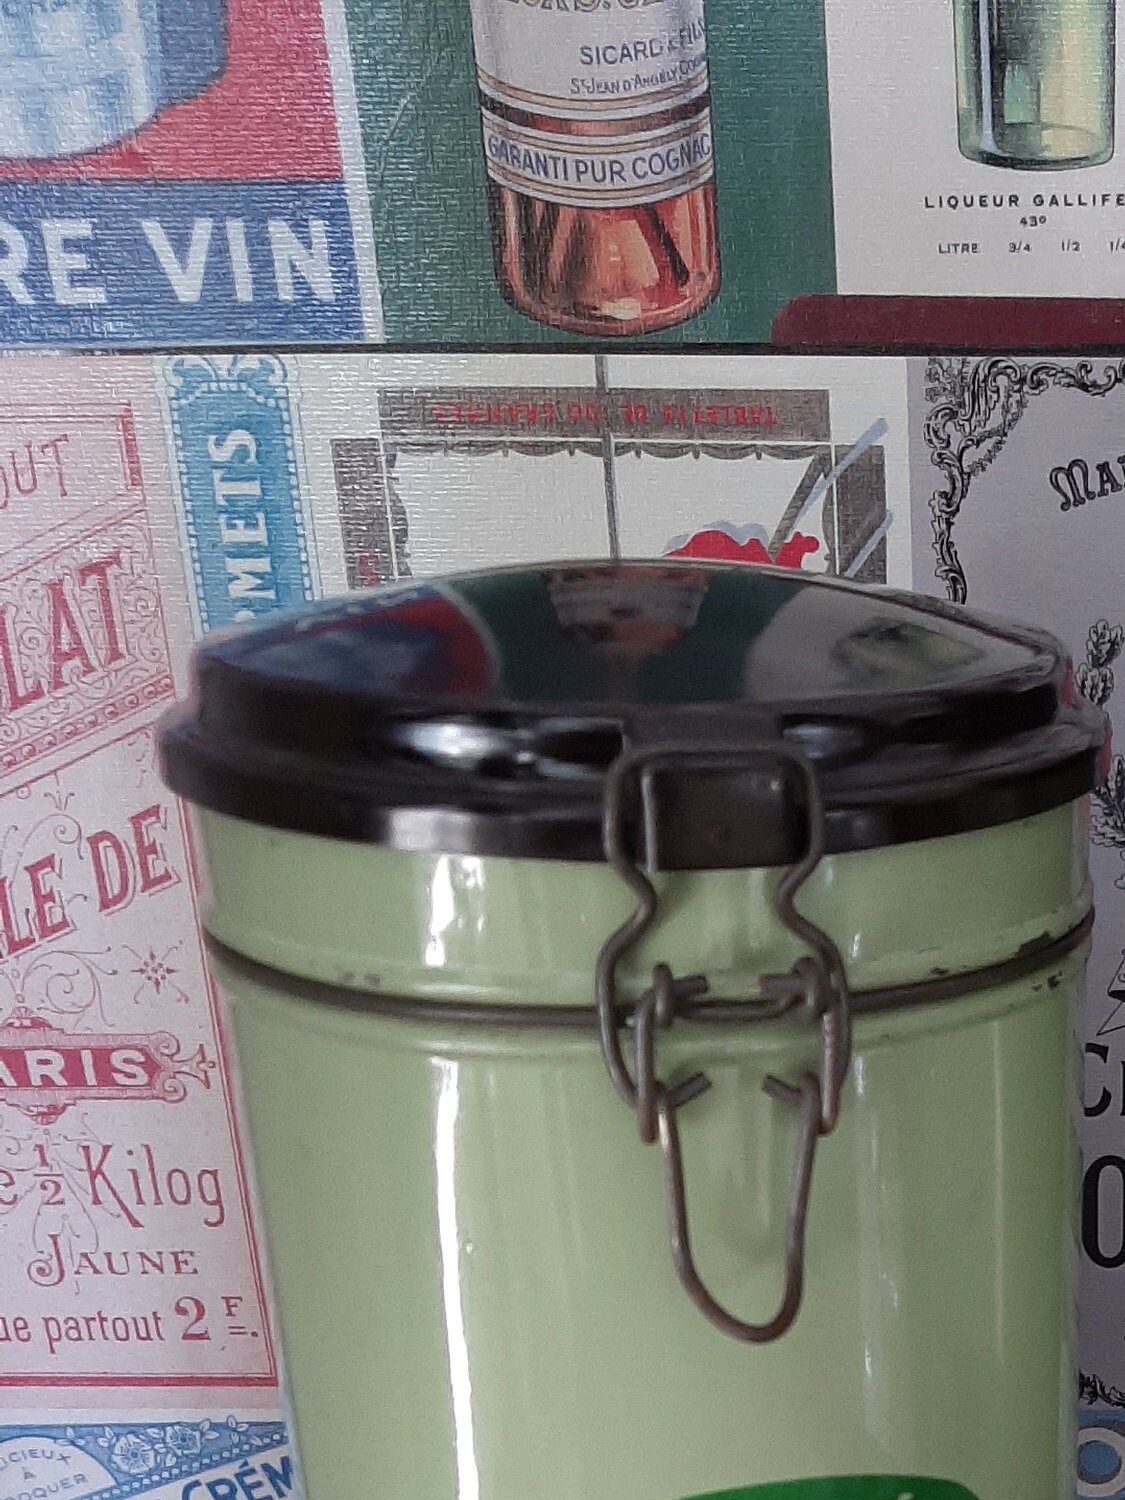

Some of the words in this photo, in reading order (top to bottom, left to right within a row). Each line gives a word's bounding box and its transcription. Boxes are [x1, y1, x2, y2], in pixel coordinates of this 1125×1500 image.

[579, 39, 664, 66] SICARD
[487, 134, 569, 182] GARANTI
[575, 158, 628, 185] PUR
[631, 132, 711, 181] COGNAC
[924, 193, 1021, 210] LIQUEUR
[140, 216, 336, 305] VIN
[938, 242, 981, 255] LITRE
[1060, 239, 1081, 252] 1/2
[206, 428, 279, 601] METS
[86, 803, 182, 917] DE
[79, 1142, 227, 1229] Kilog
[41, 1310, 165, 1354] partout
[174, 1296, 211, 1341] 2
